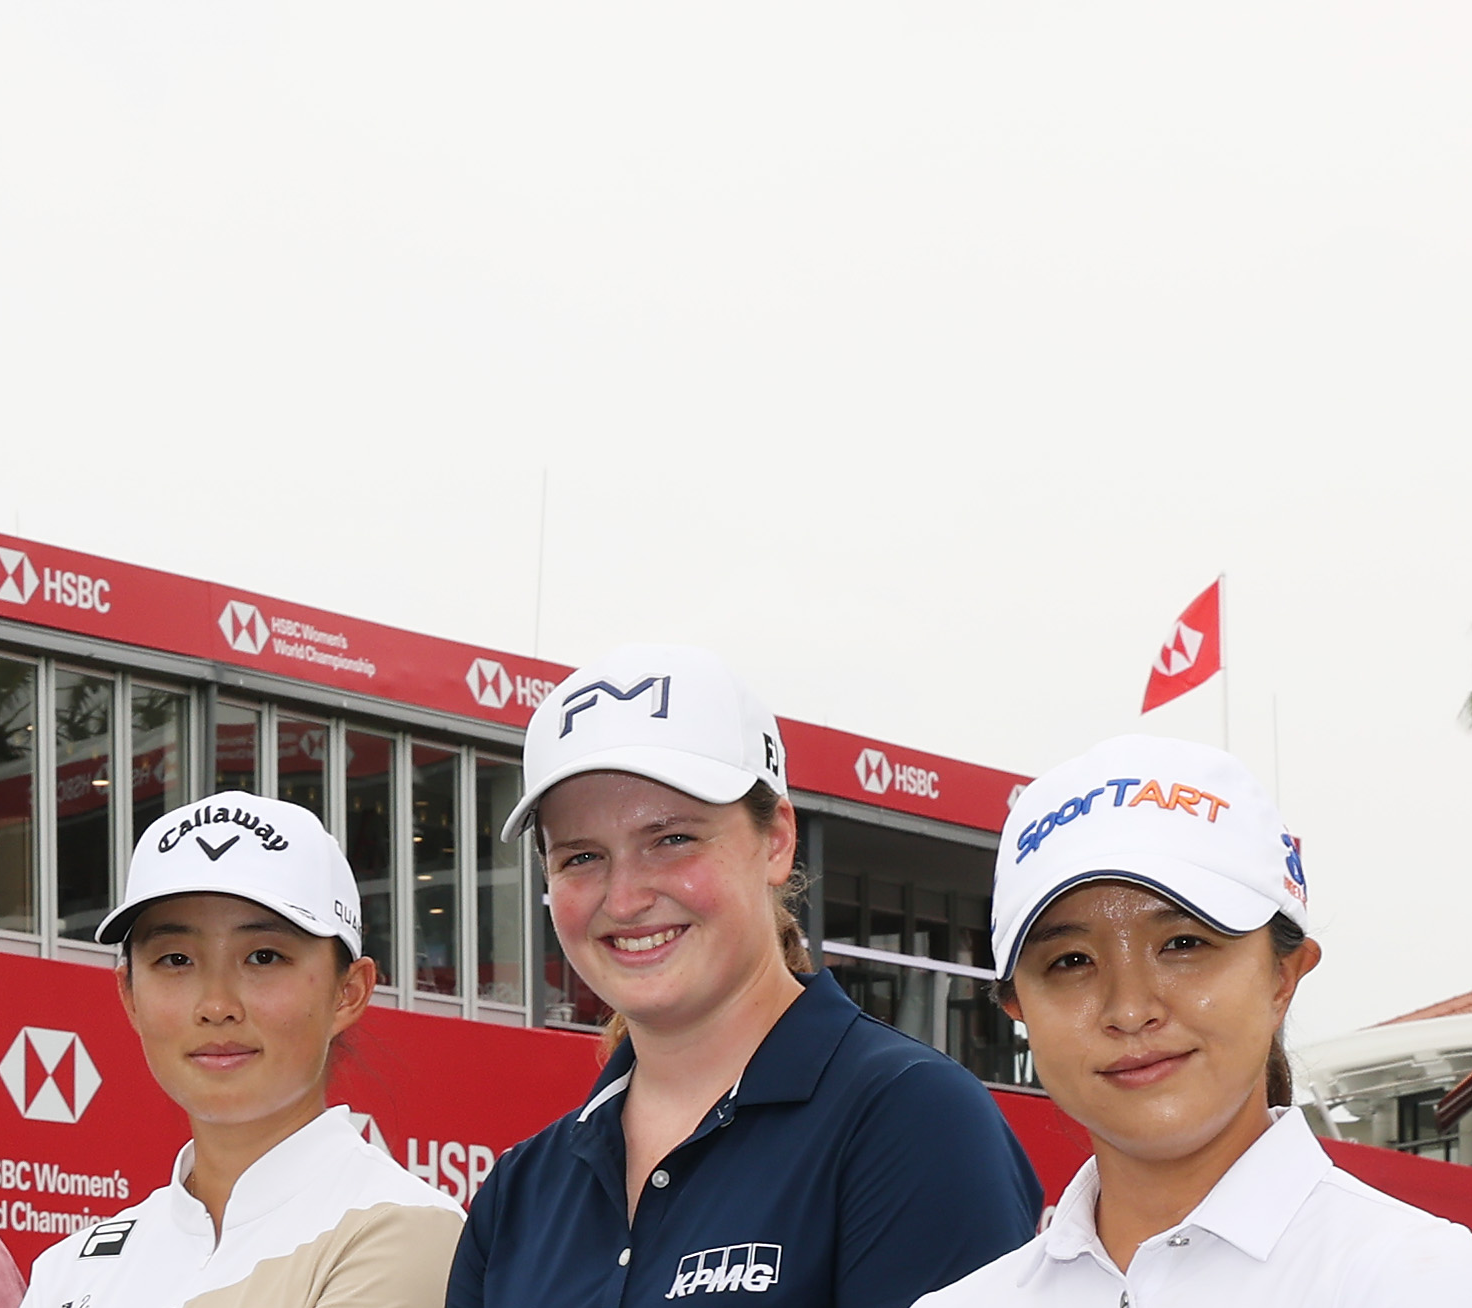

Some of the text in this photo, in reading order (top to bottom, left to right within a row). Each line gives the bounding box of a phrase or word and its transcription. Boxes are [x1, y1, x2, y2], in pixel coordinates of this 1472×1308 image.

[43, 567, 111, 613] HSBC
[271, 617, 348, 650] HSBC Women's
[273, 638, 376, 679] World Championship
[894, 762, 940, 799] HSBC
[158, 805, 289, 853] Callaway
[33, 1162, 130, 1199] Women's
[665, 1262, 775, 1300] KPMG
